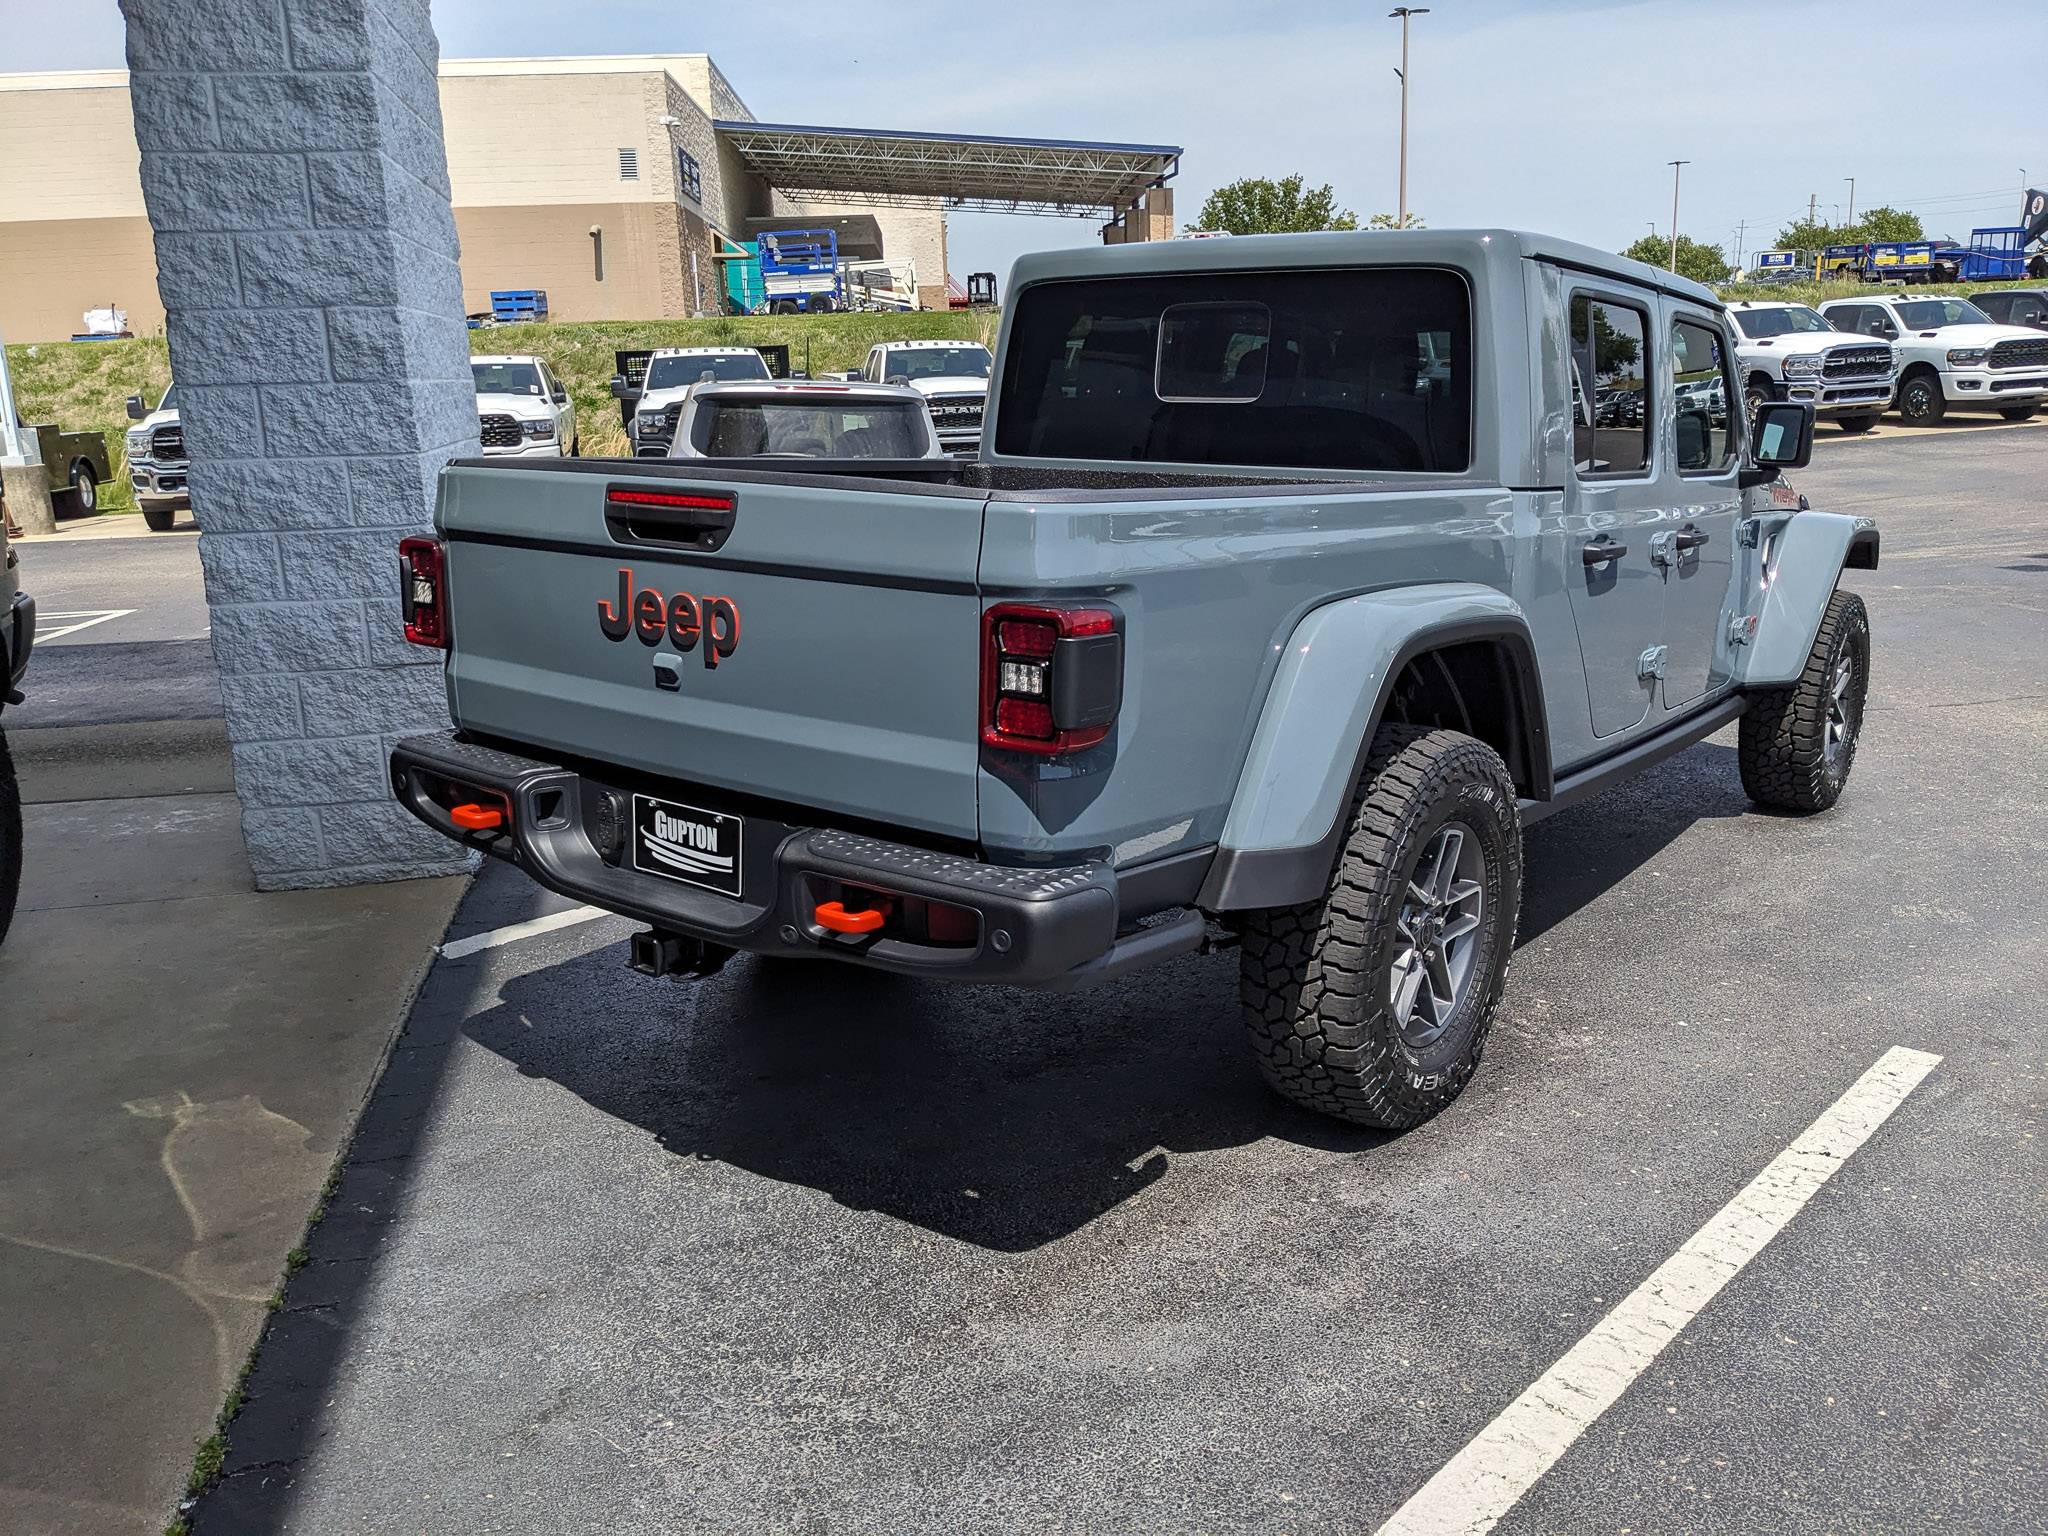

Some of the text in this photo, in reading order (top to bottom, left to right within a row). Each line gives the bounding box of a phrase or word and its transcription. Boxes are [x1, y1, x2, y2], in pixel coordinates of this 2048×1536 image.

[944, 406, 983, 414] RAM
[597, 566, 740, 666] Jeep
[655, 810, 718, 852] GUPTON
